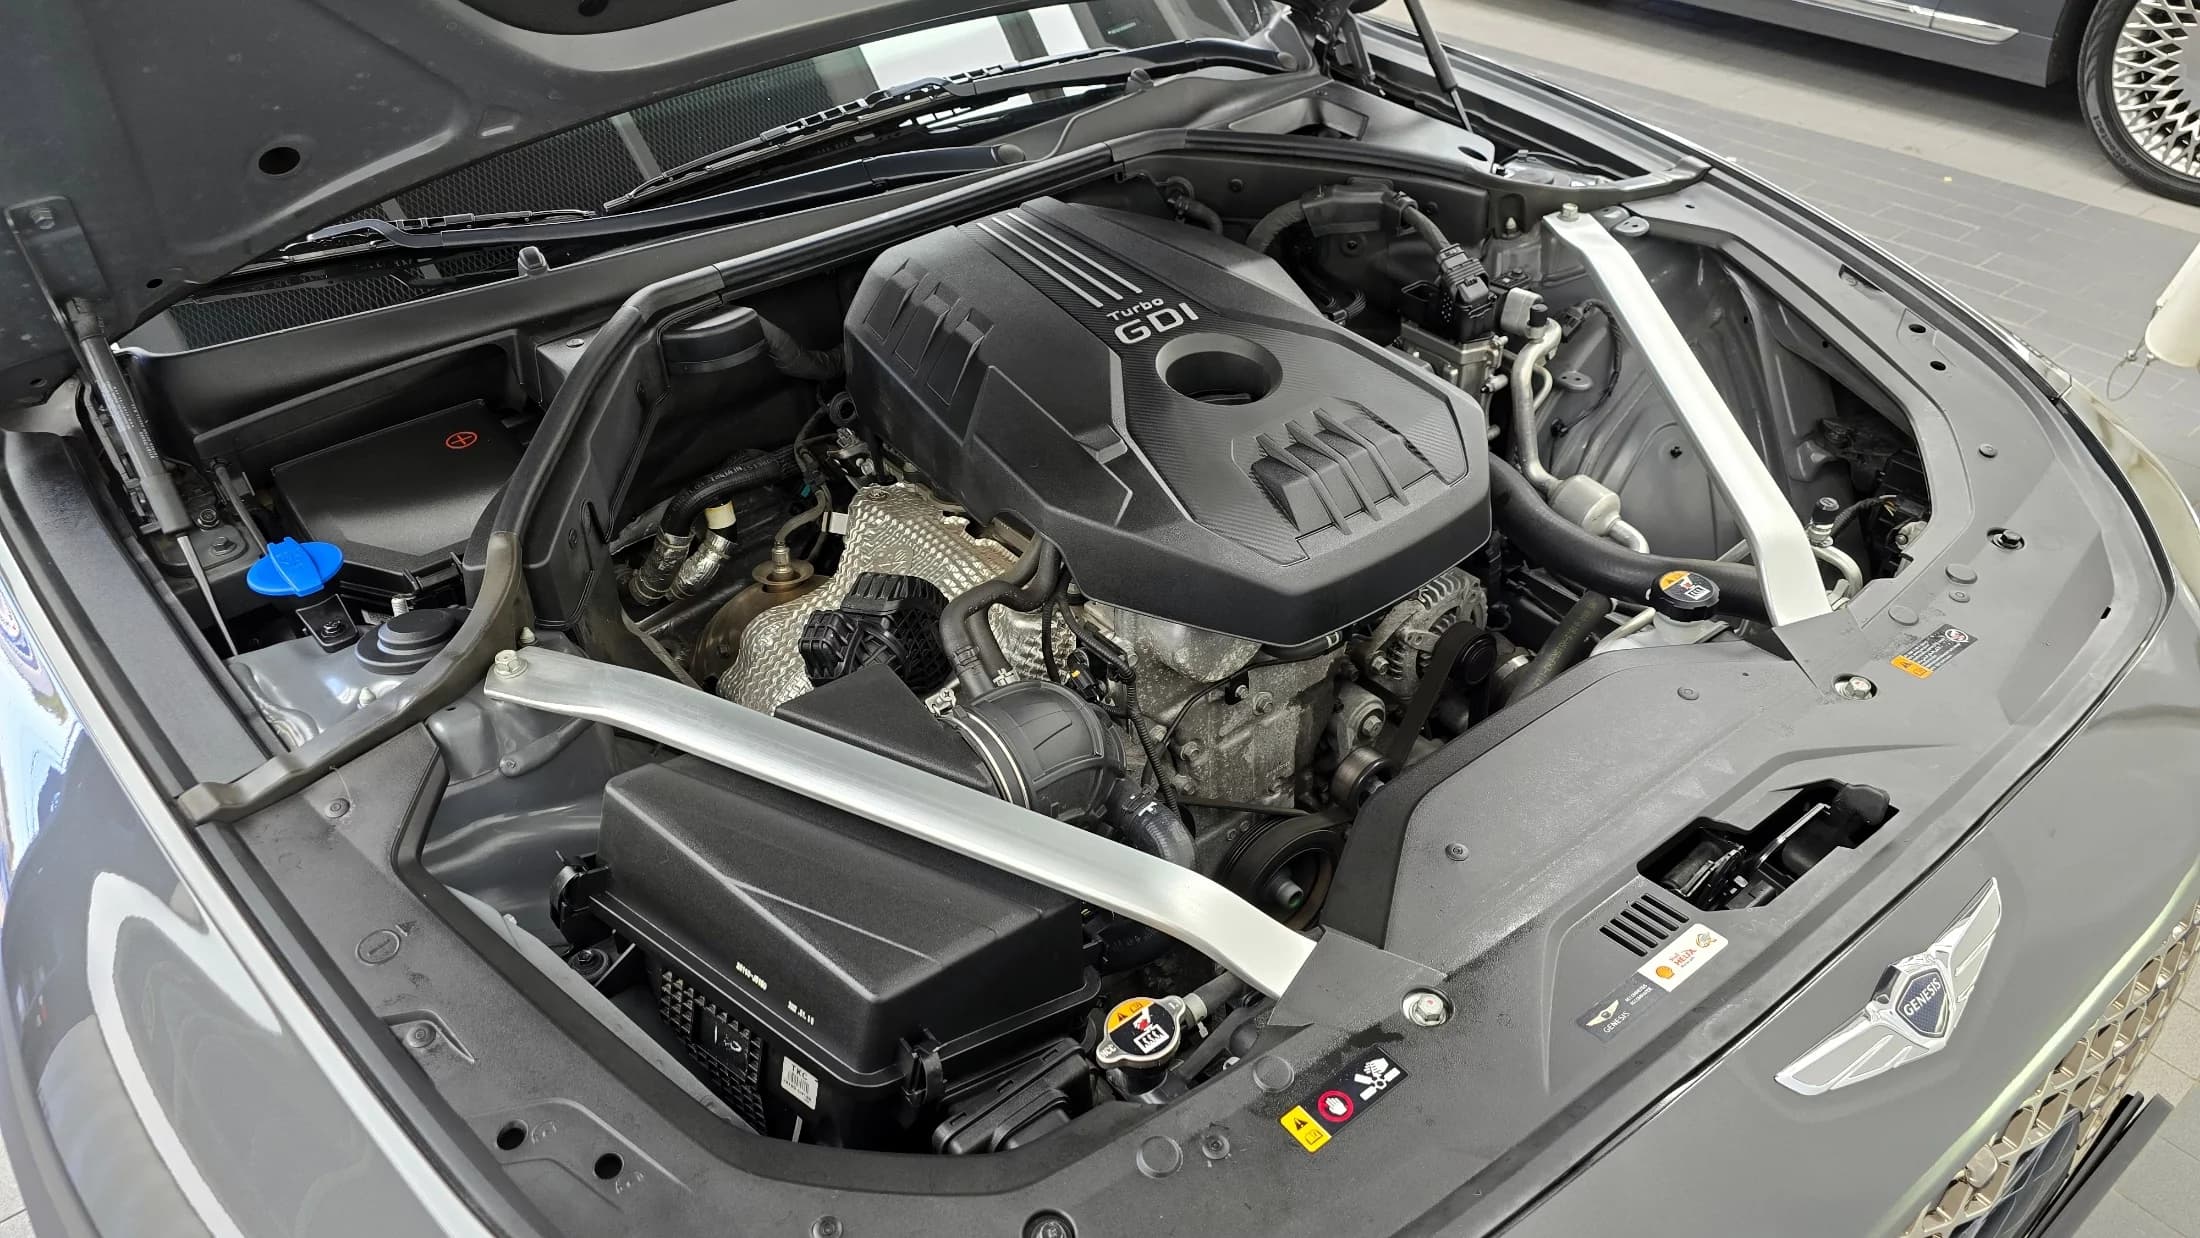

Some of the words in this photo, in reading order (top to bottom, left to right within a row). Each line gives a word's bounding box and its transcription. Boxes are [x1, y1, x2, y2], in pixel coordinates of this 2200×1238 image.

[1106, 298, 1164, 320] Turbo
[1114, 302, 1199, 344] GDI
[1673, 948, 1697, 966] HELIX
[1903, 978, 1941, 1016] GENESIS
[1603, 1010, 1631, 1033] GENESIS
